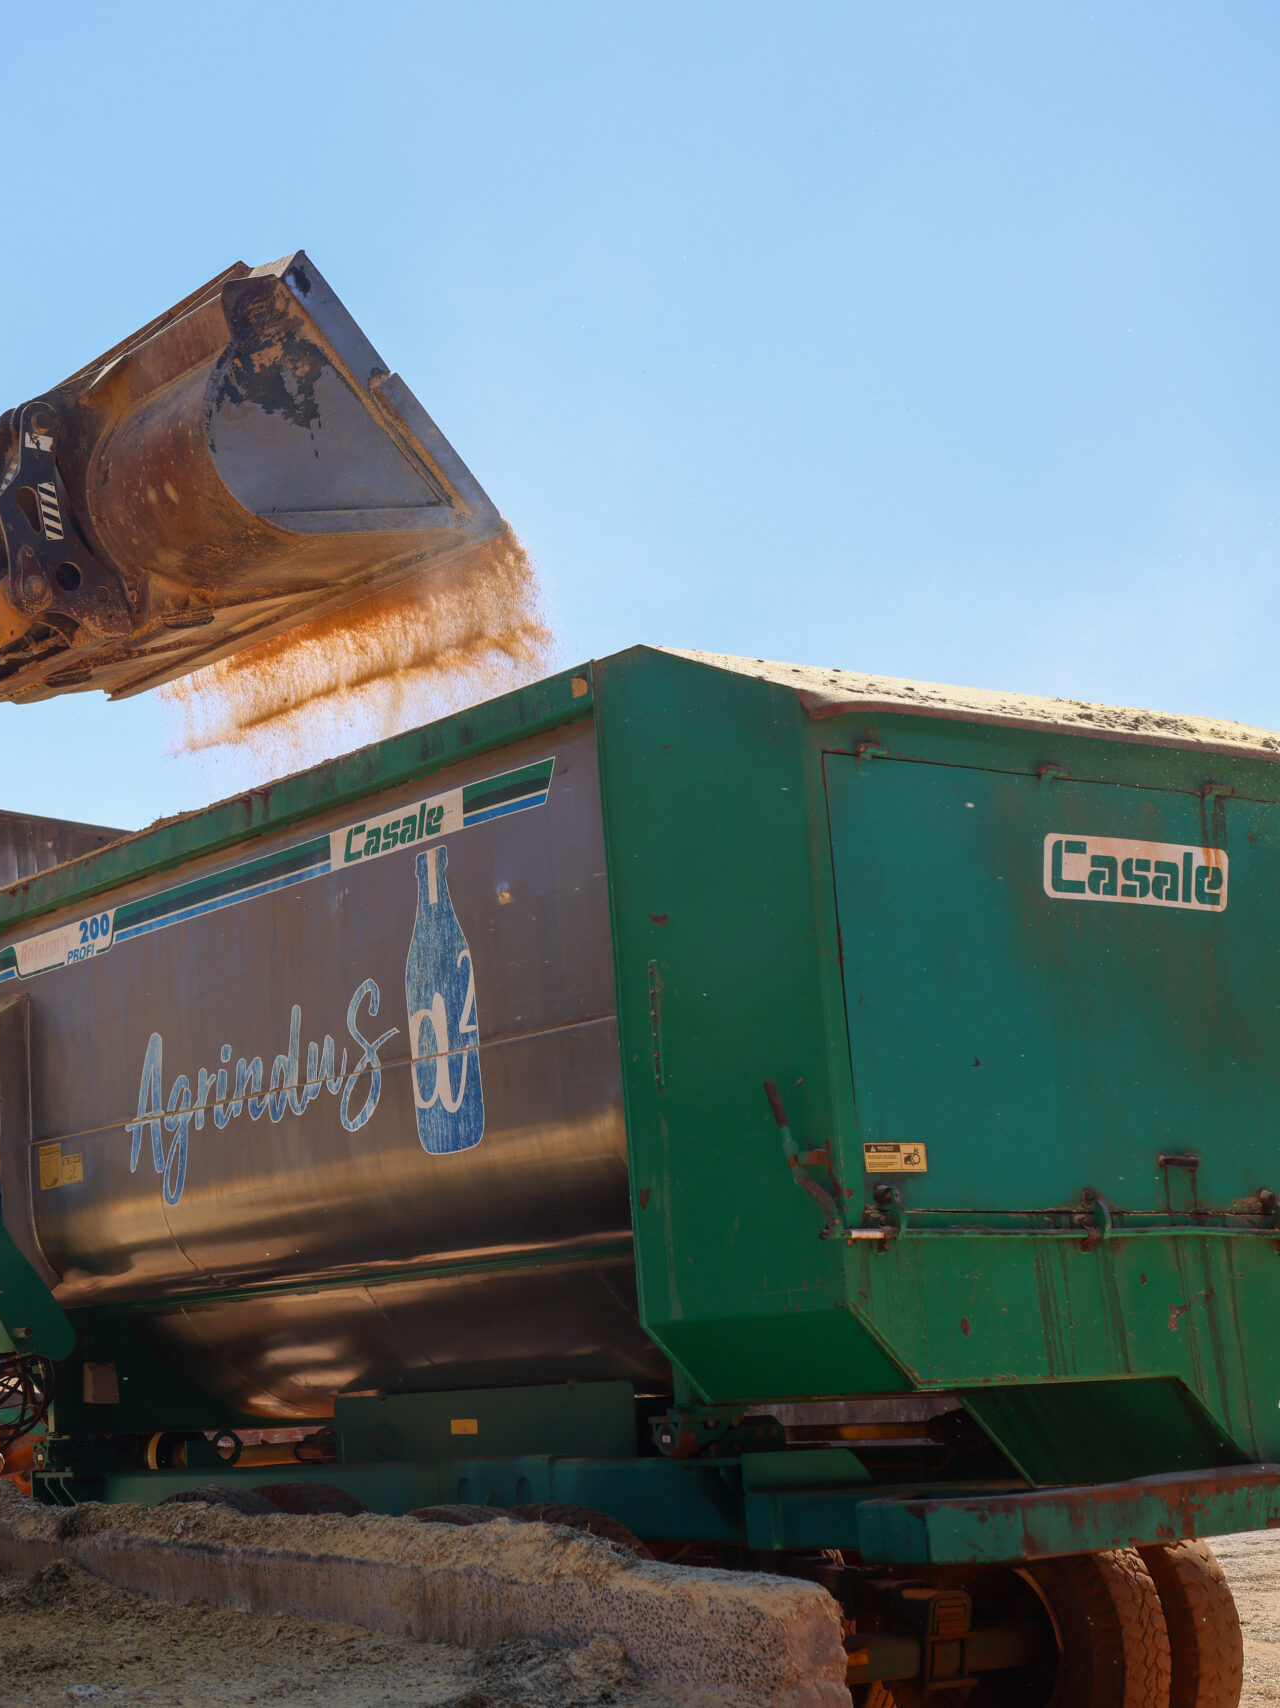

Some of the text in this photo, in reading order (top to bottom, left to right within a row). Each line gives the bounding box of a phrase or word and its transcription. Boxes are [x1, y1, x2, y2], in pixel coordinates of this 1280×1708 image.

[343, 801, 445, 864] Casale
[1051, 839, 1224, 907] Casale
[79, 913, 110, 944] 200
[67, 942, 96, 965] PROFI
